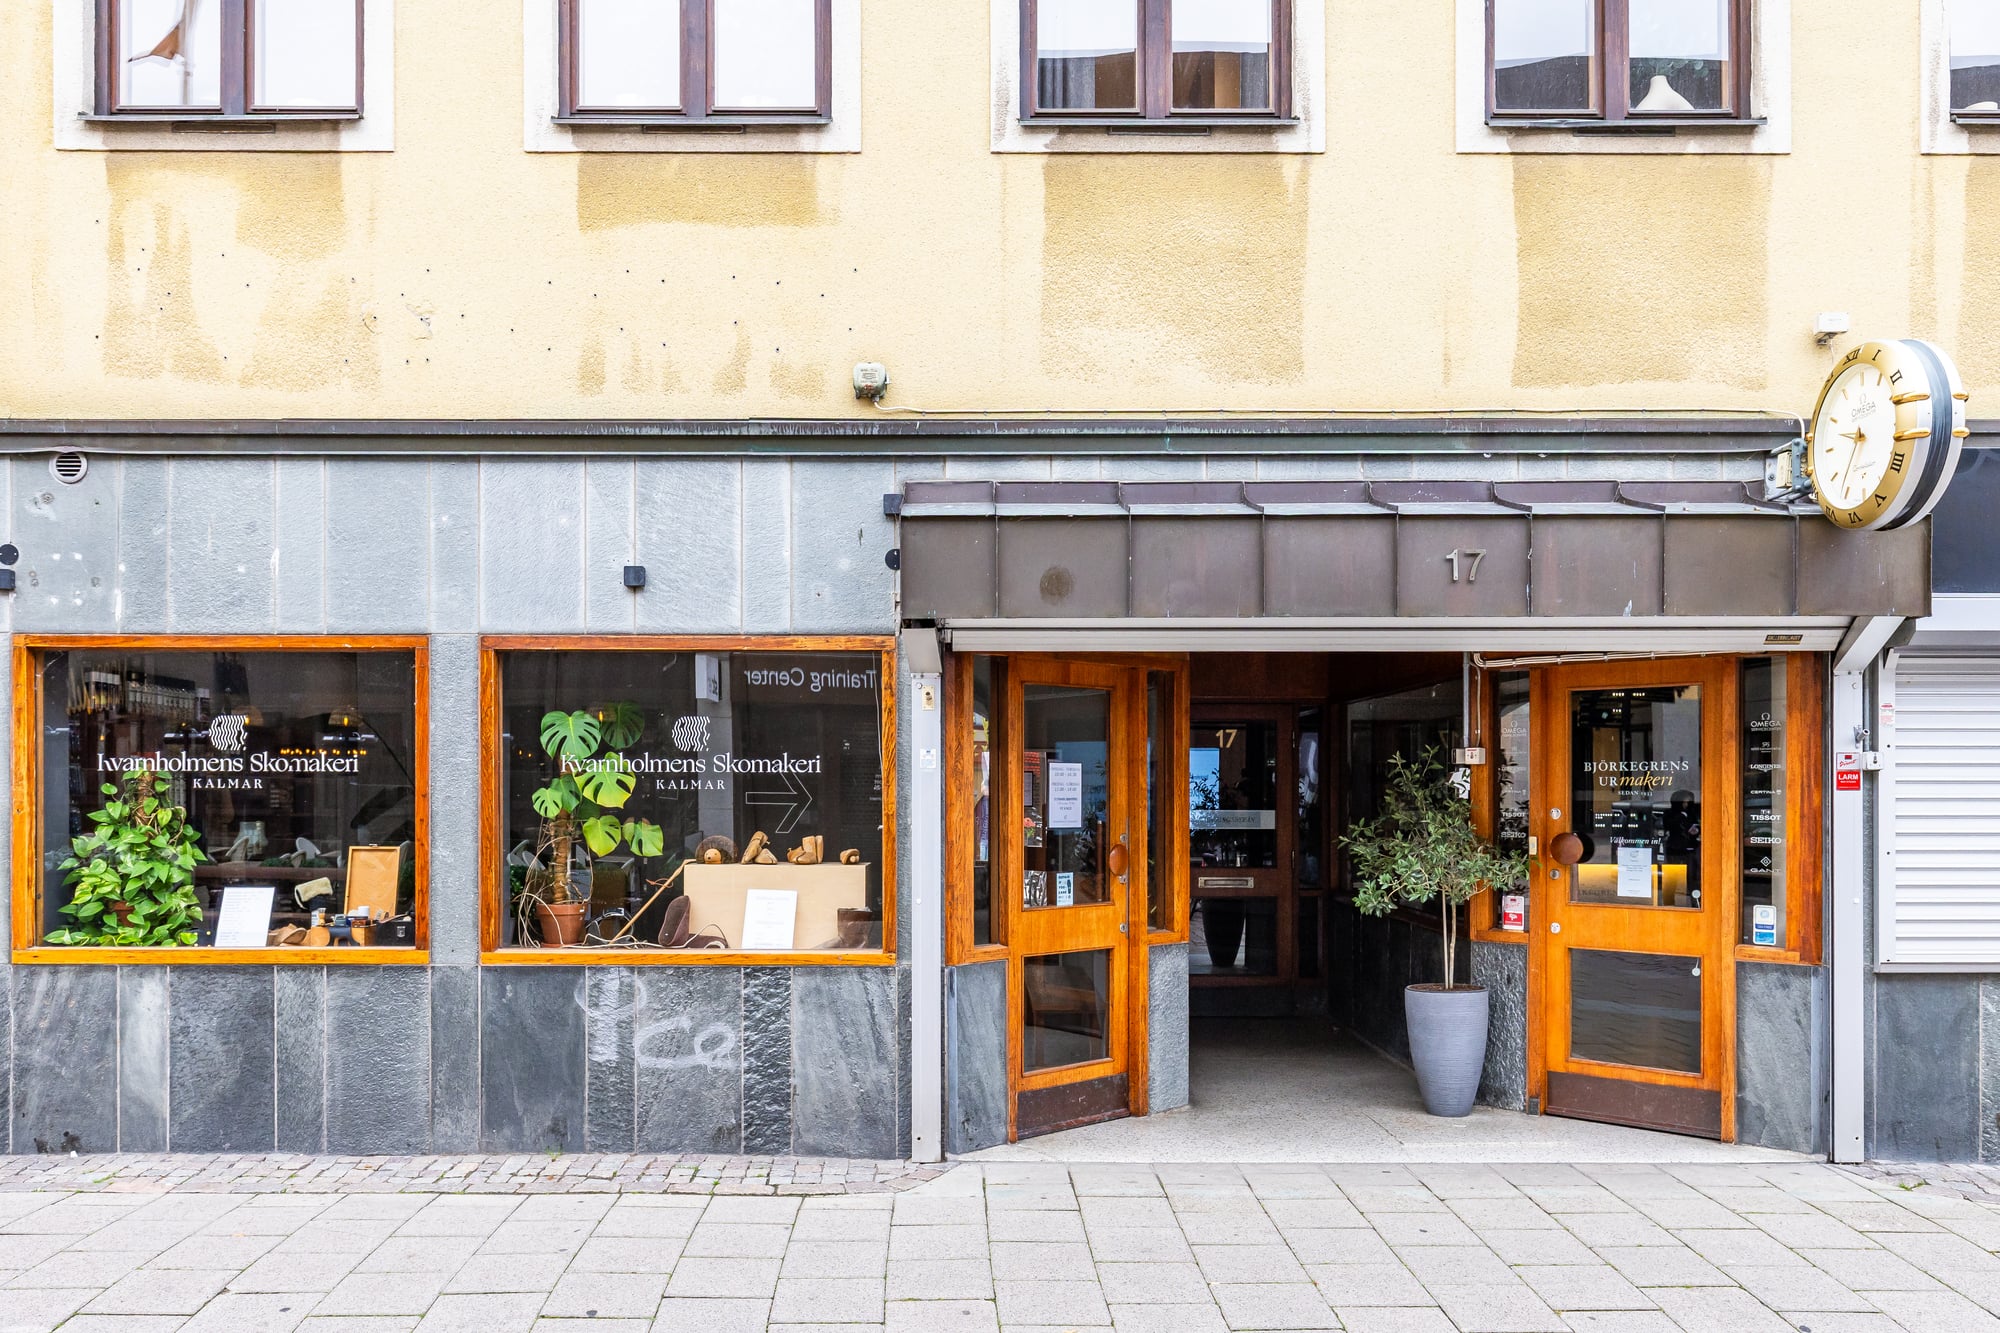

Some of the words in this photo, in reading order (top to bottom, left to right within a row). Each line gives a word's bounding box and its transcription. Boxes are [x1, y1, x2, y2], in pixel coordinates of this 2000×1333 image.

[1851, 401, 1876, 418] OMEGA
[1446, 548, 1487, 581] 17
[1750, 720, 1782, 728] OMEGA
[1215, 730, 1238, 749] 17
[250, 750, 359, 773] Skomakeri
[560, 752, 706, 774] Kvarnholmens
[713, 752, 823, 774] Skomakeri
[1584, 759, 1689, 774] BJÖRKEGRENS
[192, 778, 264, 789] KALMAR
[1838, 773, 1859, 781] LARM
[656, 779, 726, 790] KALMAR
[1609, 836, 1650, 846] Välkommen
[1651, 837, 1661, 846] in!
[1750, 836, 1782, 844] SEIKO
